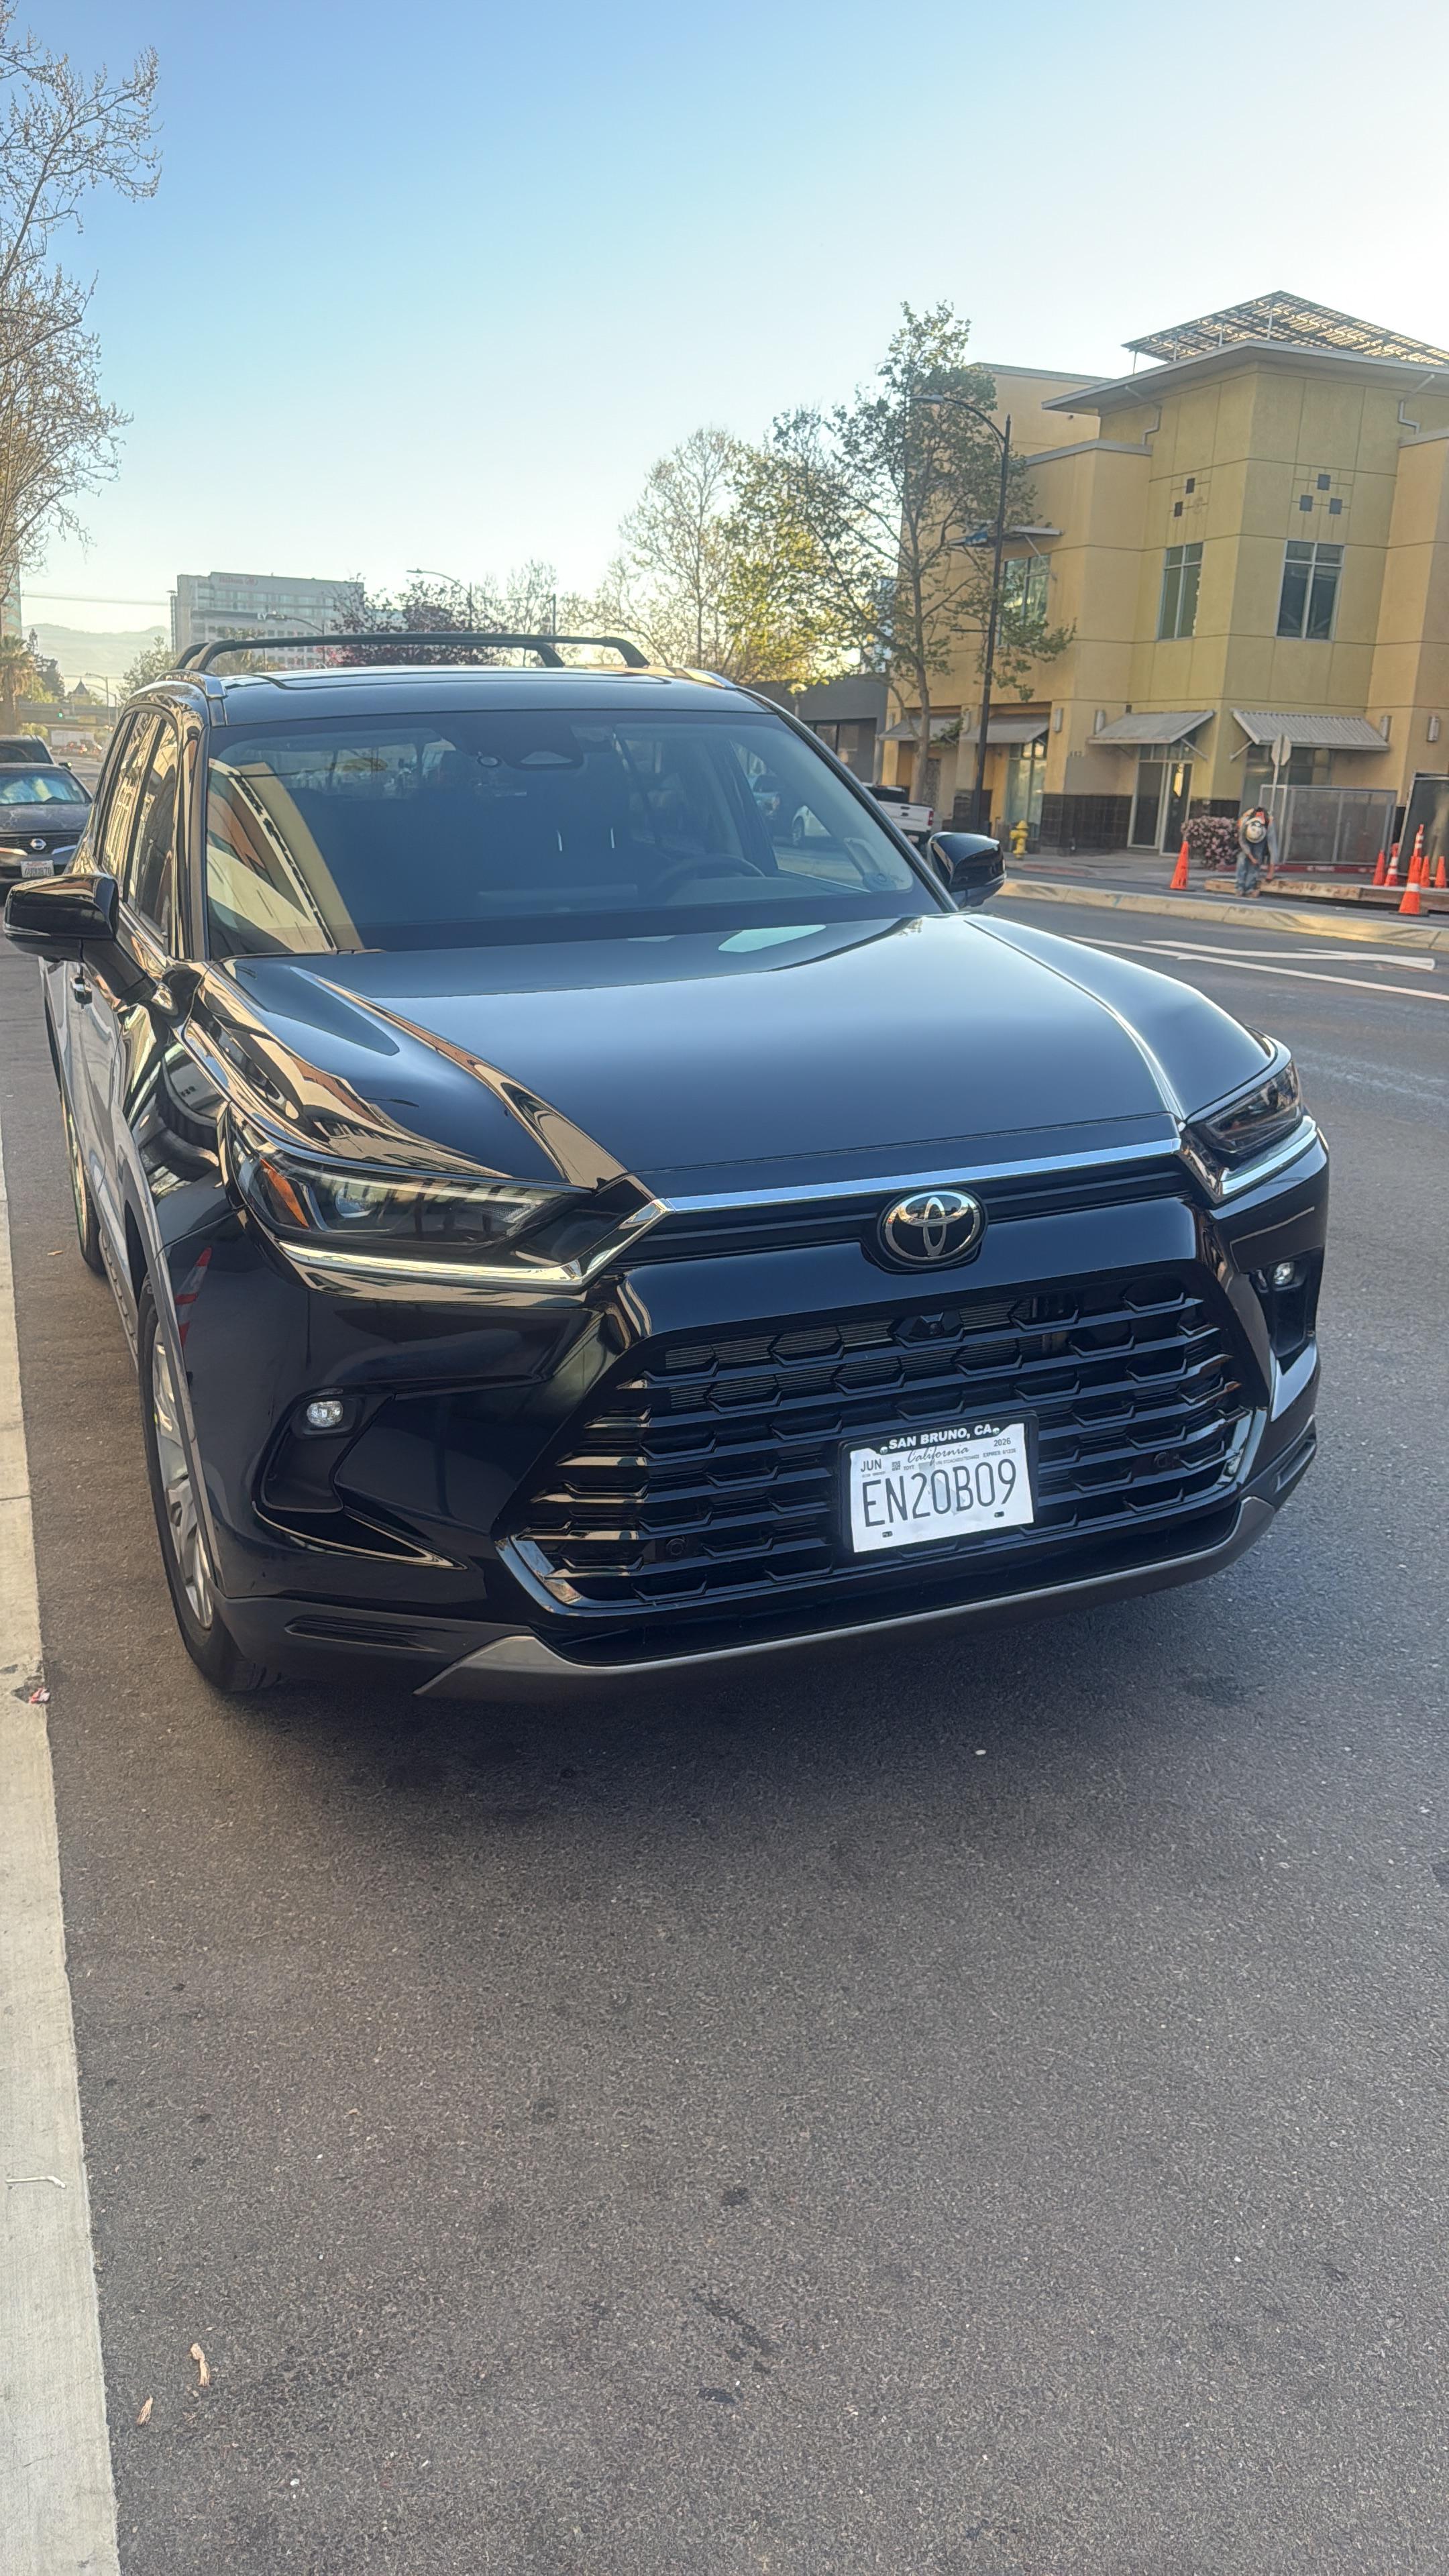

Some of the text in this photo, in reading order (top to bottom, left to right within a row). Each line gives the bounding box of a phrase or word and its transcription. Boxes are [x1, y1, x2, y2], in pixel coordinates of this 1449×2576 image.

[888, 1424, 992, 1450] SAN BRUNO, CA
[993, 1437, 1012, 1447] 2026
[860, 1458, 882, 1472] JUN
[907, 1443, 970, 1466] California
[862, 1458, 1017, 1527] EN20B09
